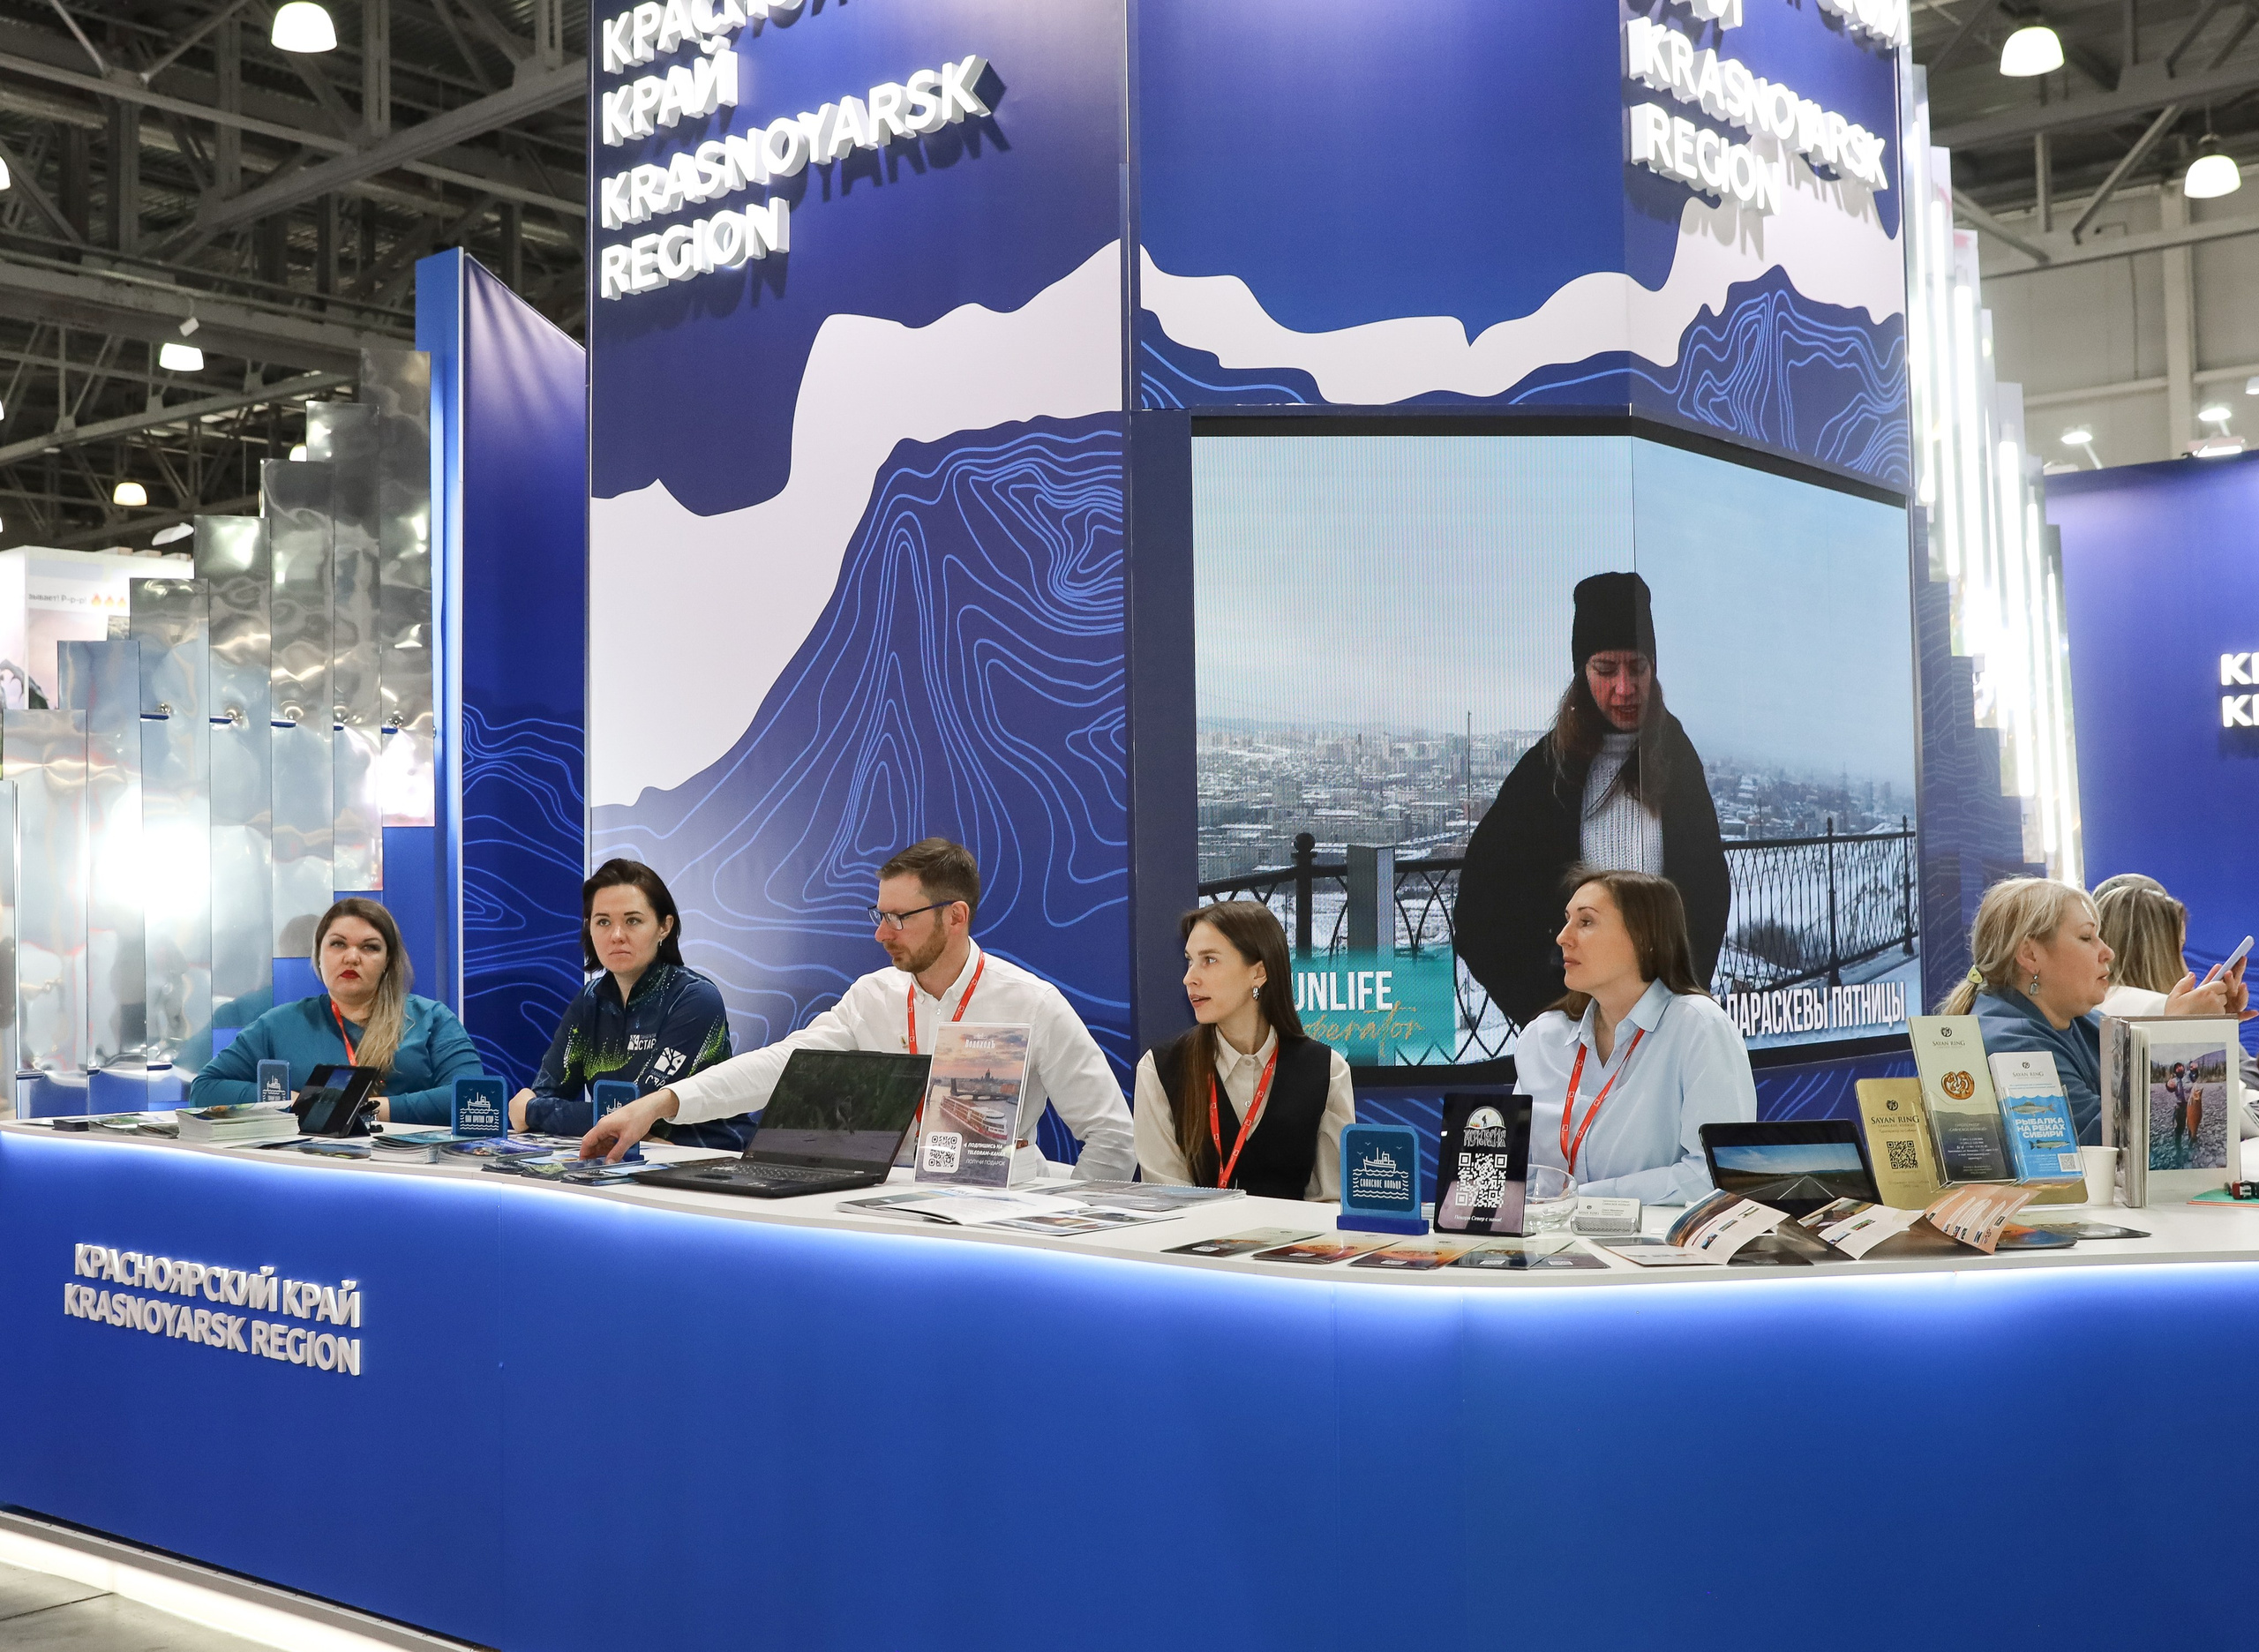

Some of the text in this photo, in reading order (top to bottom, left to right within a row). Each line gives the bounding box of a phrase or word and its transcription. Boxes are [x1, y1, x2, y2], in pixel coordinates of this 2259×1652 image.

[602, 34, 739, 146] КРАЙ
[1627, 16, 1888, 191] KRASNOYARSK
[601, 54, 995, 230] KRASNOYARSK
[1630, 101, 1781, 217] REGION
[600, 196, 791, 301] REGION
[1727, 980, 1906, 1037] ПАРАСКЕВЫ ПЯТНИЦЫ
[1897, 1115, 1920, 1123] RING
[2015, 1116, 2065, 1126] РЫБАЛКА
[2023, 1130, 2064, 1138] СИБИРИ
[2031, 1123, 2067, 1132] РЕКАХ
[64, 1282, 361, 1376] KRASNOYARSK REGION
[74, 1243, 361, 1328] КРАСНОЯРСКИЙ КРАЙ
